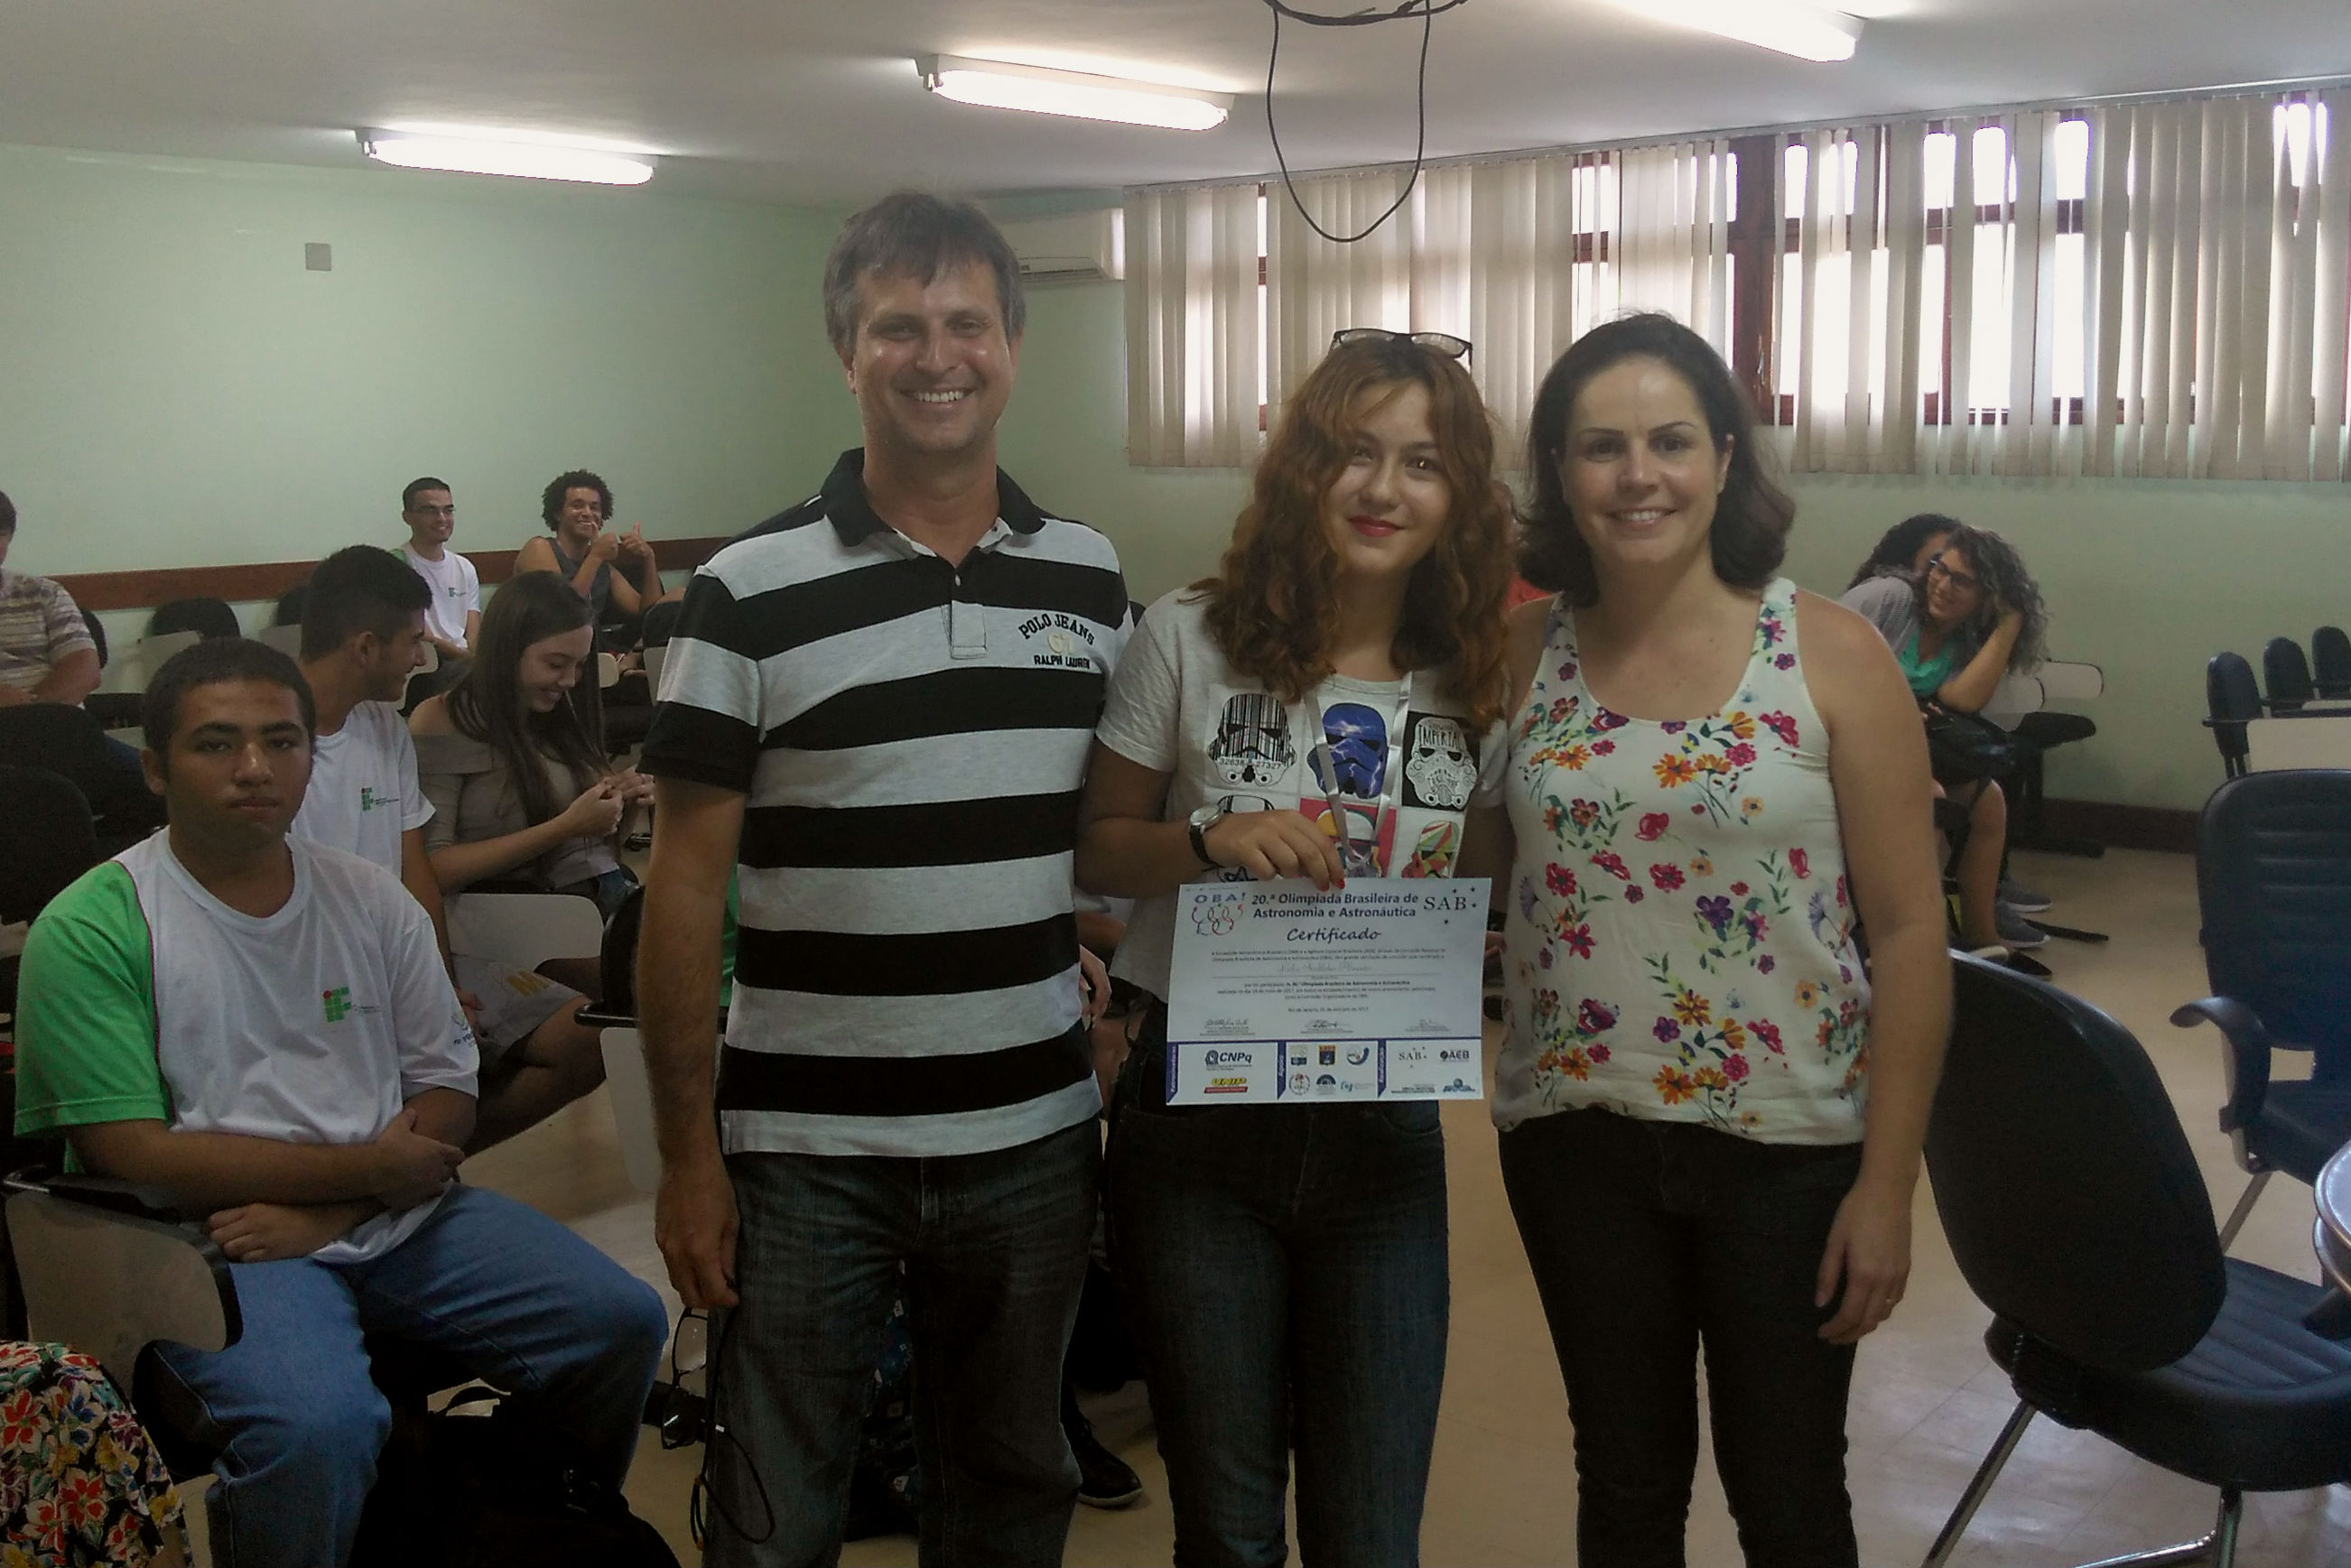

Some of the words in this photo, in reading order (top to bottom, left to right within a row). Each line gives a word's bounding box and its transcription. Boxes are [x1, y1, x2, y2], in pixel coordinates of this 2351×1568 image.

[1018, 614, 1052, 639] POLO
[1055, 614, 1094, 645] JEANS
[1034, 654, 1063, 665] RALPH
[1344, 893, 1399, 904] Brasileira
[1403, 893, 1418, 903] de
[1423, 896, 1466, 911] SAB
[1253, 906, 1324, 918] Astronomia
[1339, 906, 1417, 917] Astronáutica
[1287, 928, 1382, 943] Certificado
[1219, 1052, 1252, 1063] CNPq
[1399, 1052, 1422, 1061] SAB
[1449, 1050, 1470, 1060] AEB
